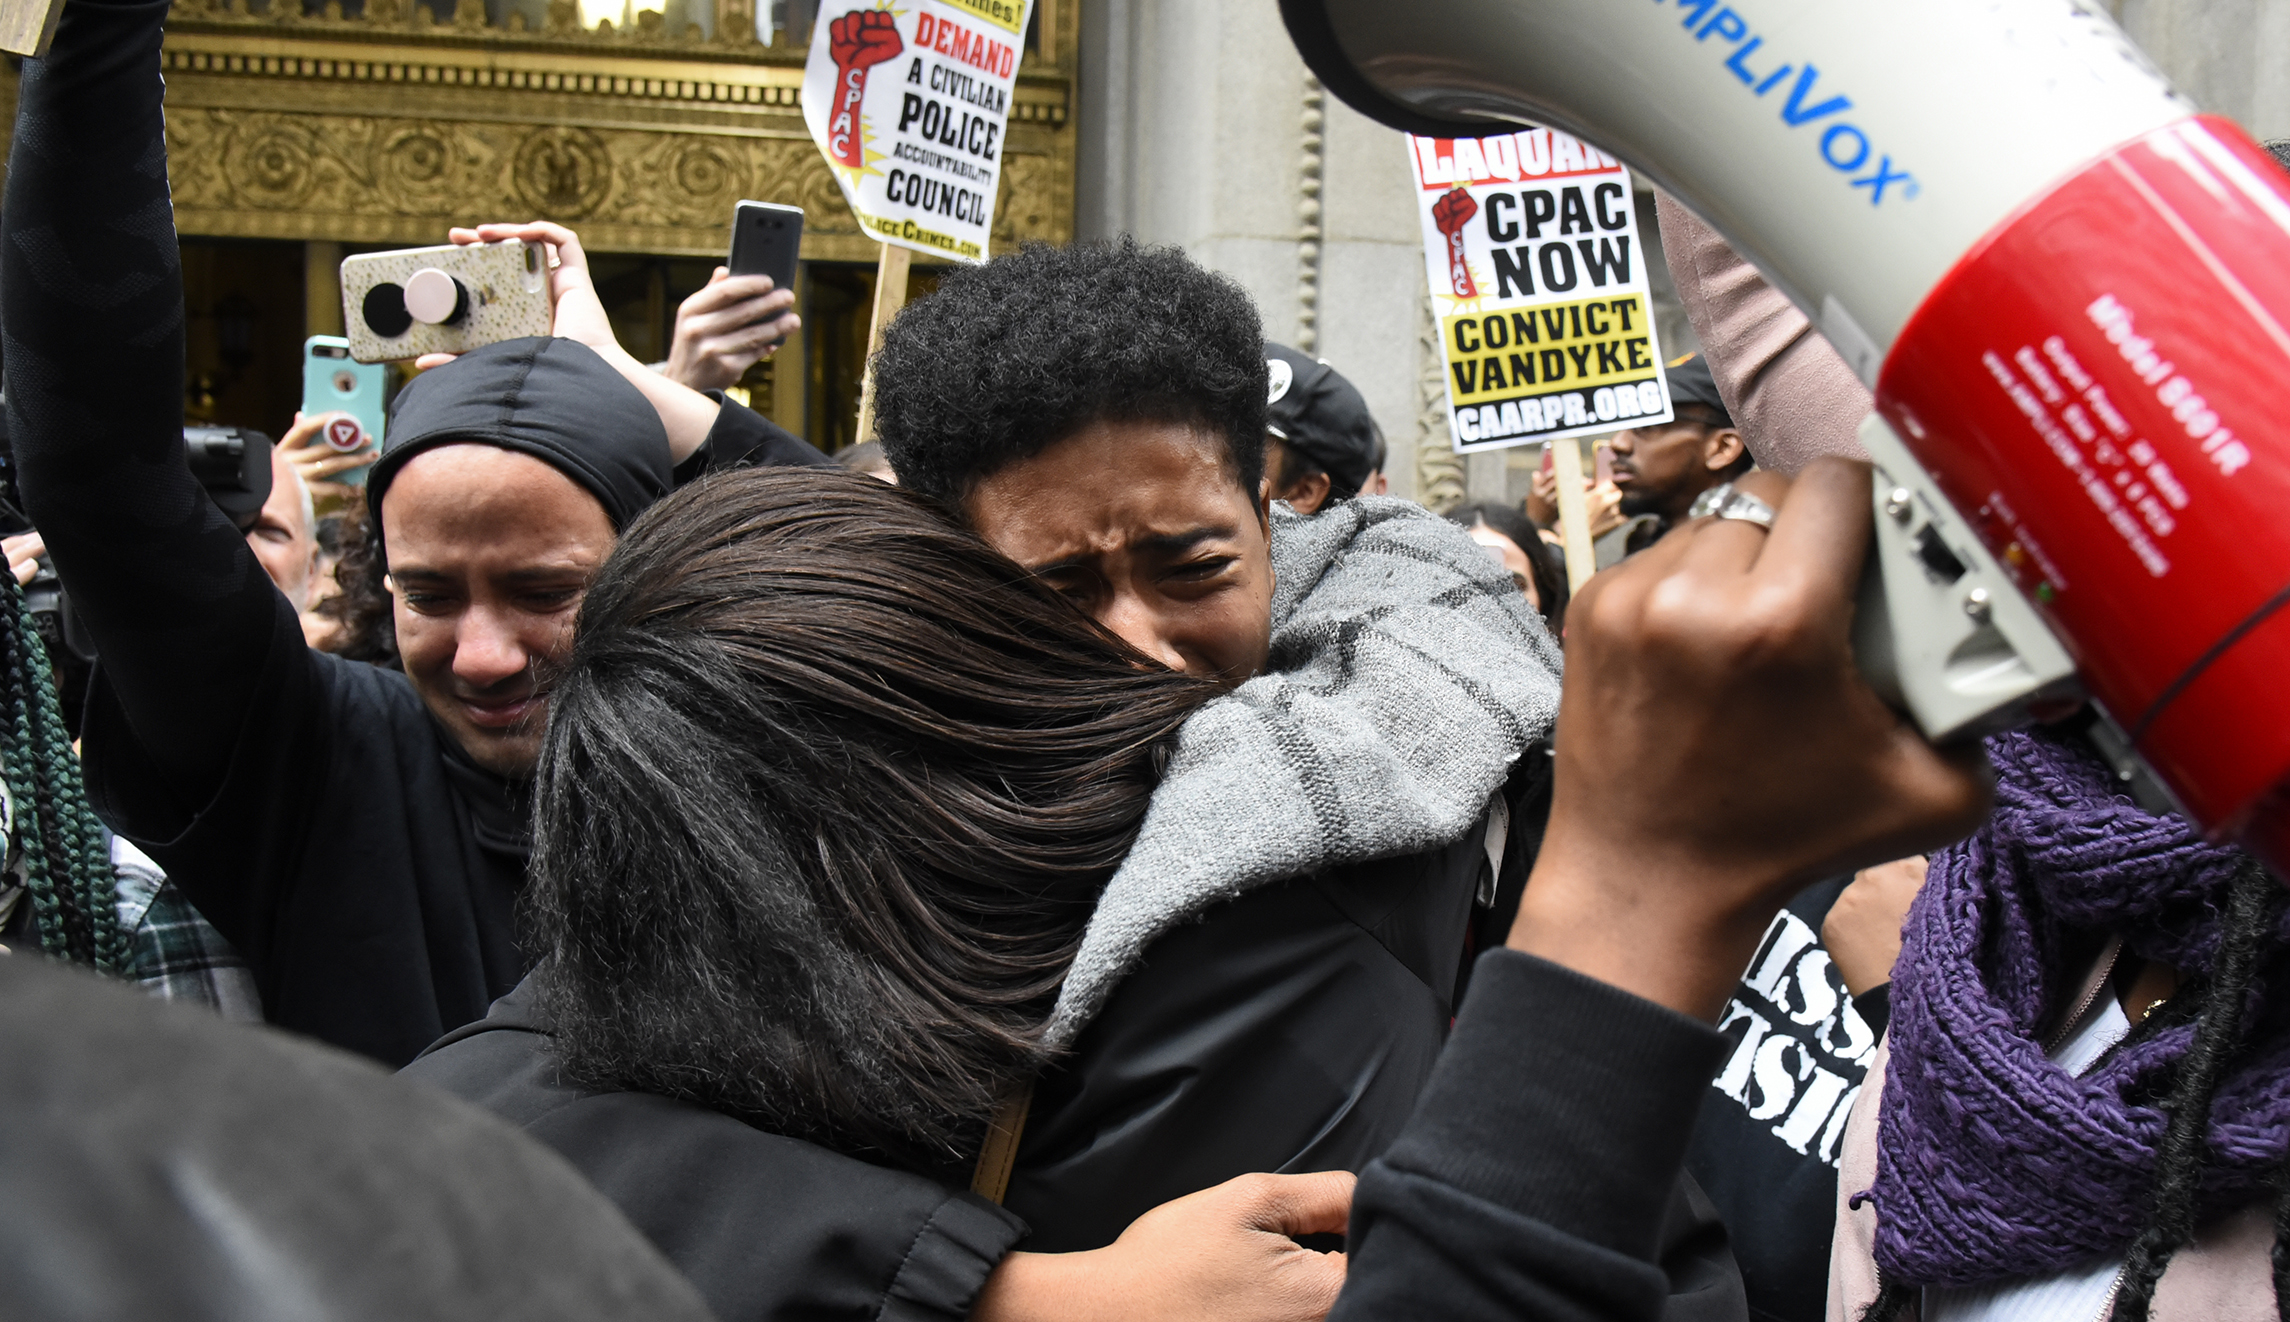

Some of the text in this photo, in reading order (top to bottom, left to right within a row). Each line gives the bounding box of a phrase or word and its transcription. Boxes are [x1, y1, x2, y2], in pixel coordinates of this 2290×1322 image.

[914, 11, 1015, 80] DEMAND
[831, 68, 863, 159] CPAC
[907, 57, 1007, 116] A CIVILIAN
[898, 91, 999, 162] POLICE
[893, 141, 993, 186] ACCOUNTABILITY
[886, 168, 986, 227] COUNCIL
[1485, 182, 1628, 243] CPAC
[1450, 230, 1470, 296] CPAC
[1491, 235, 1631, 299] NOW
[1453, 298, 1638, 353] CONVICT
[1451, 336, 1654, 395] VANDYKE
[1456, 380, 1664, 442] CAARPR.ORG
[1740, 908, 1877, 1069] ISS
